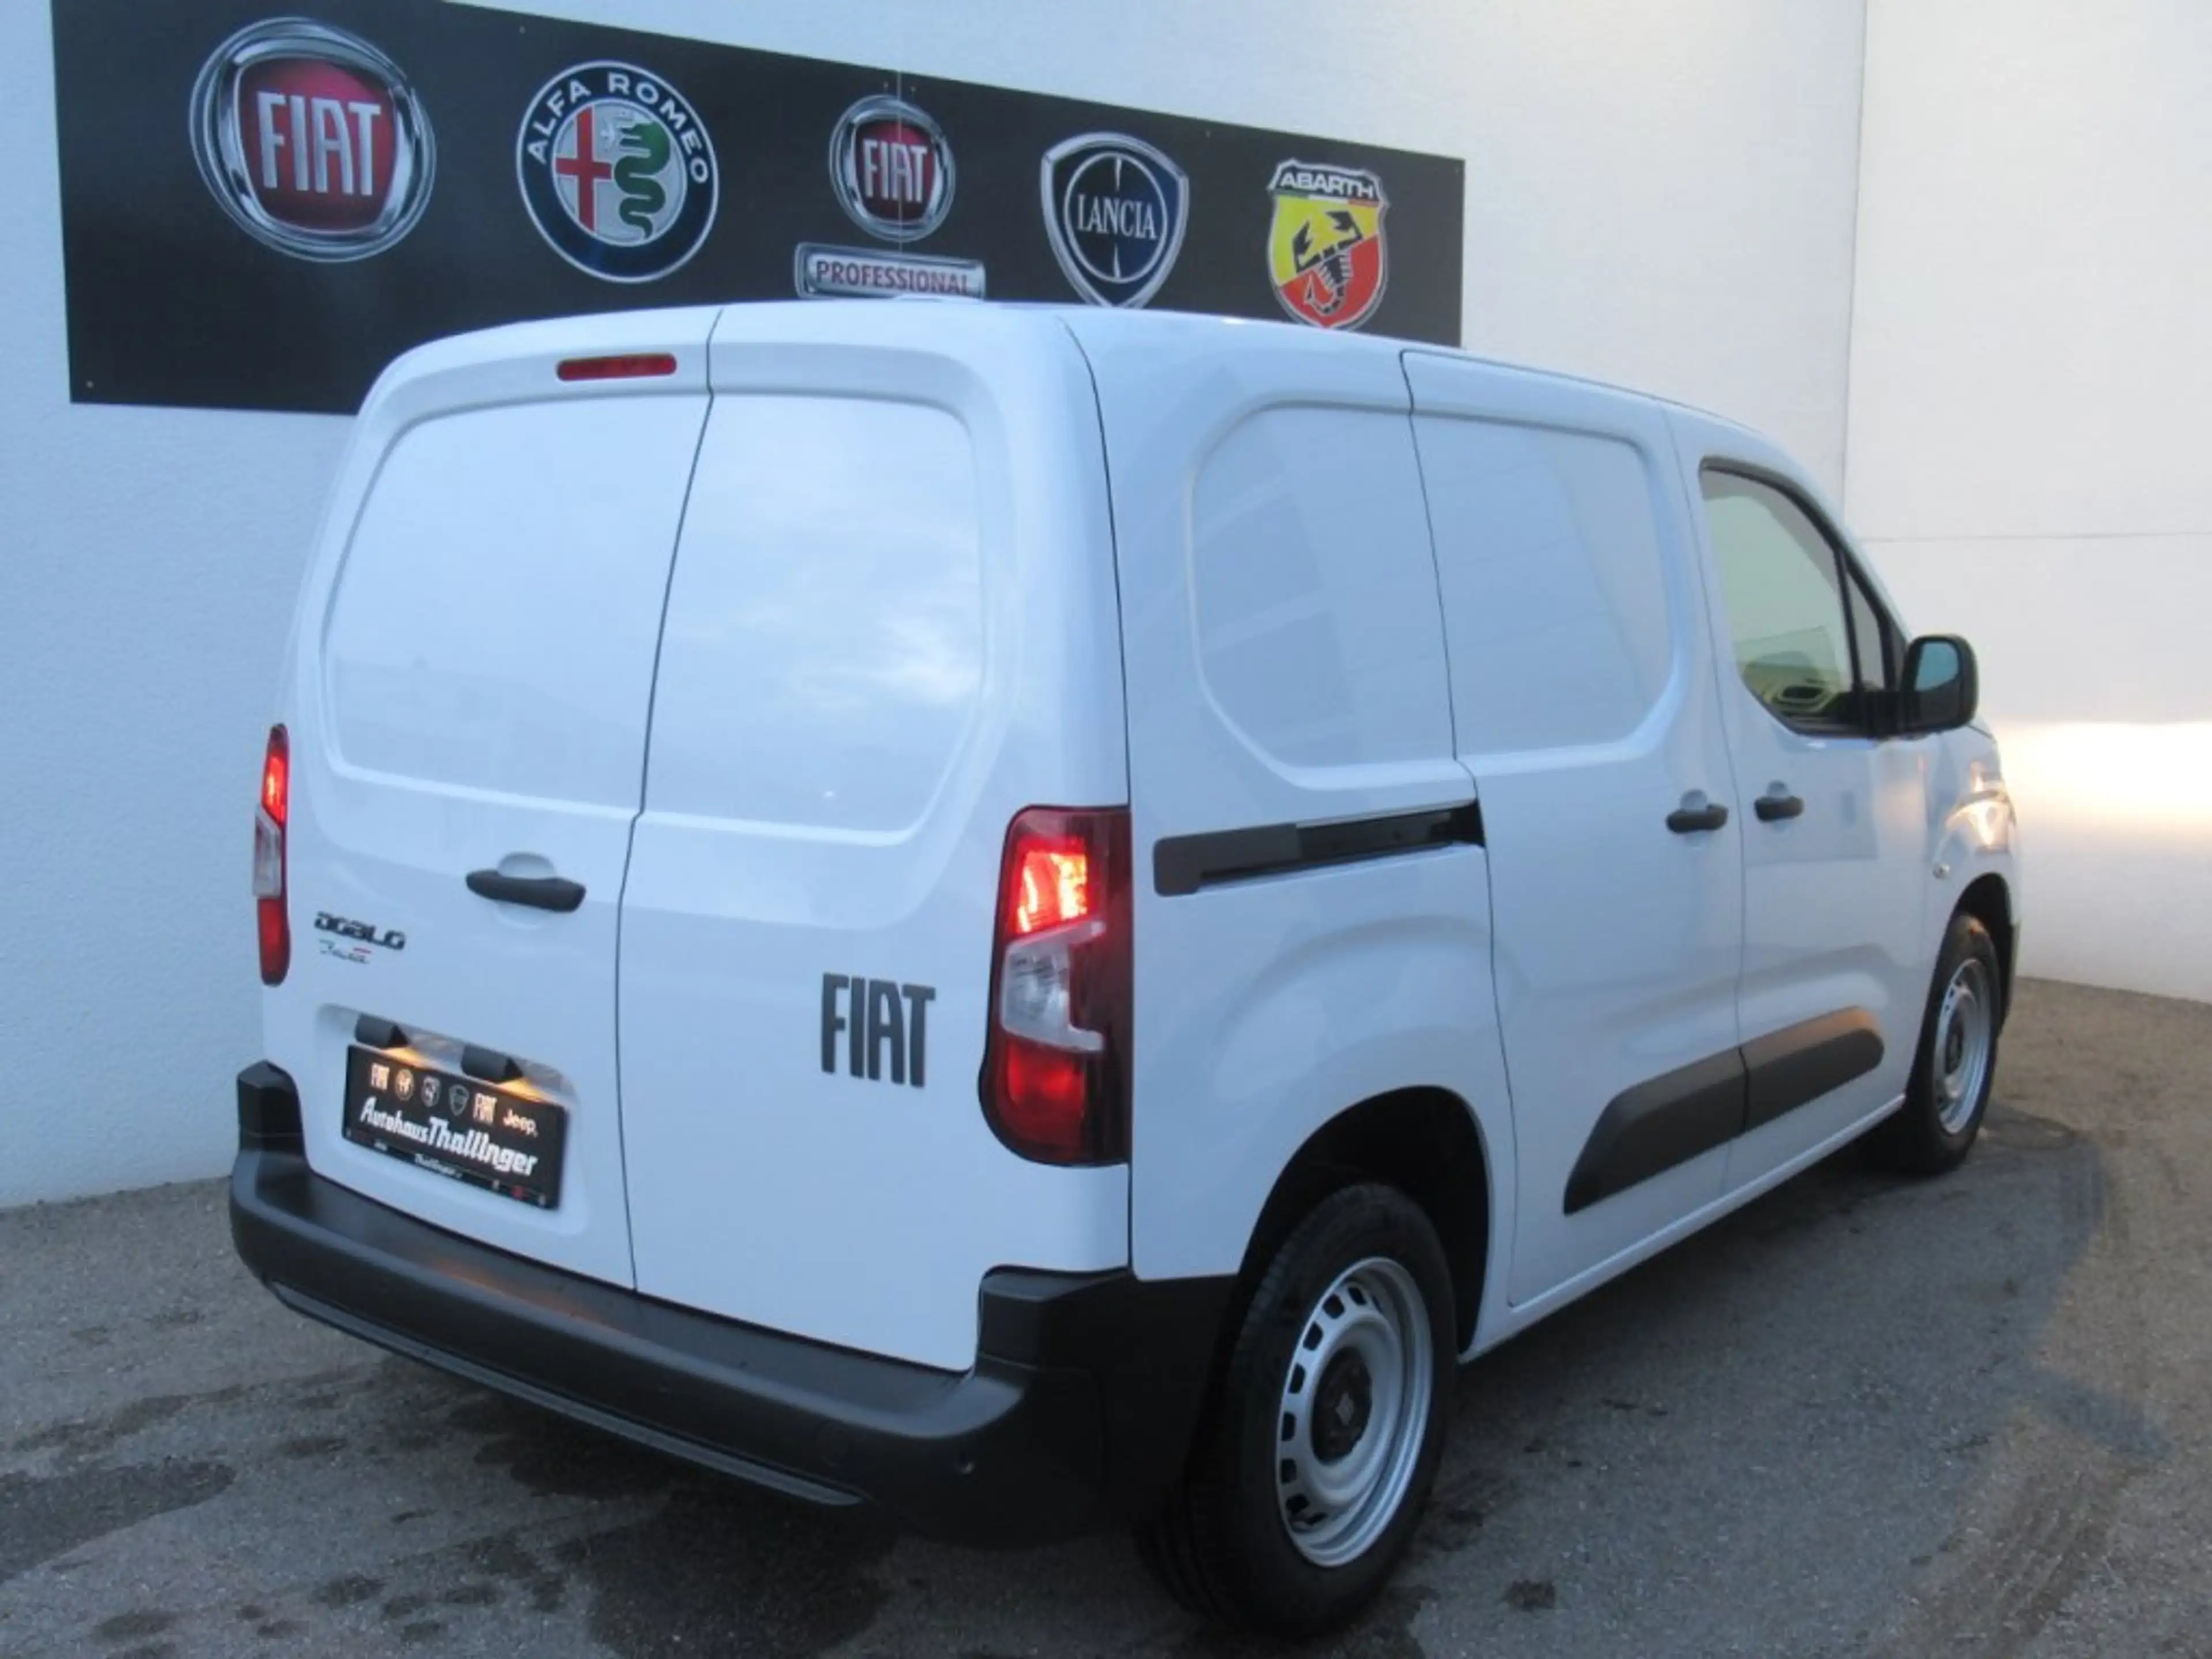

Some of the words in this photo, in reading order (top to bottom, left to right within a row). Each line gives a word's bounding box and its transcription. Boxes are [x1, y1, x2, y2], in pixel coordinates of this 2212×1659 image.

[256, 91, 381, 196] FIAT
[527, 78, 592, 165] ALFA
[608, 71, 708, 183] ROMEO
[862, 139, 927, 203] FIAT
[1280, 172, 1374, 199] ABARTH
[1078, 192, 1158, 241] LANCIA
[816, 260, 969, 294] PROFESSIONAL
[821, 972, 936, 1089] FIAT
